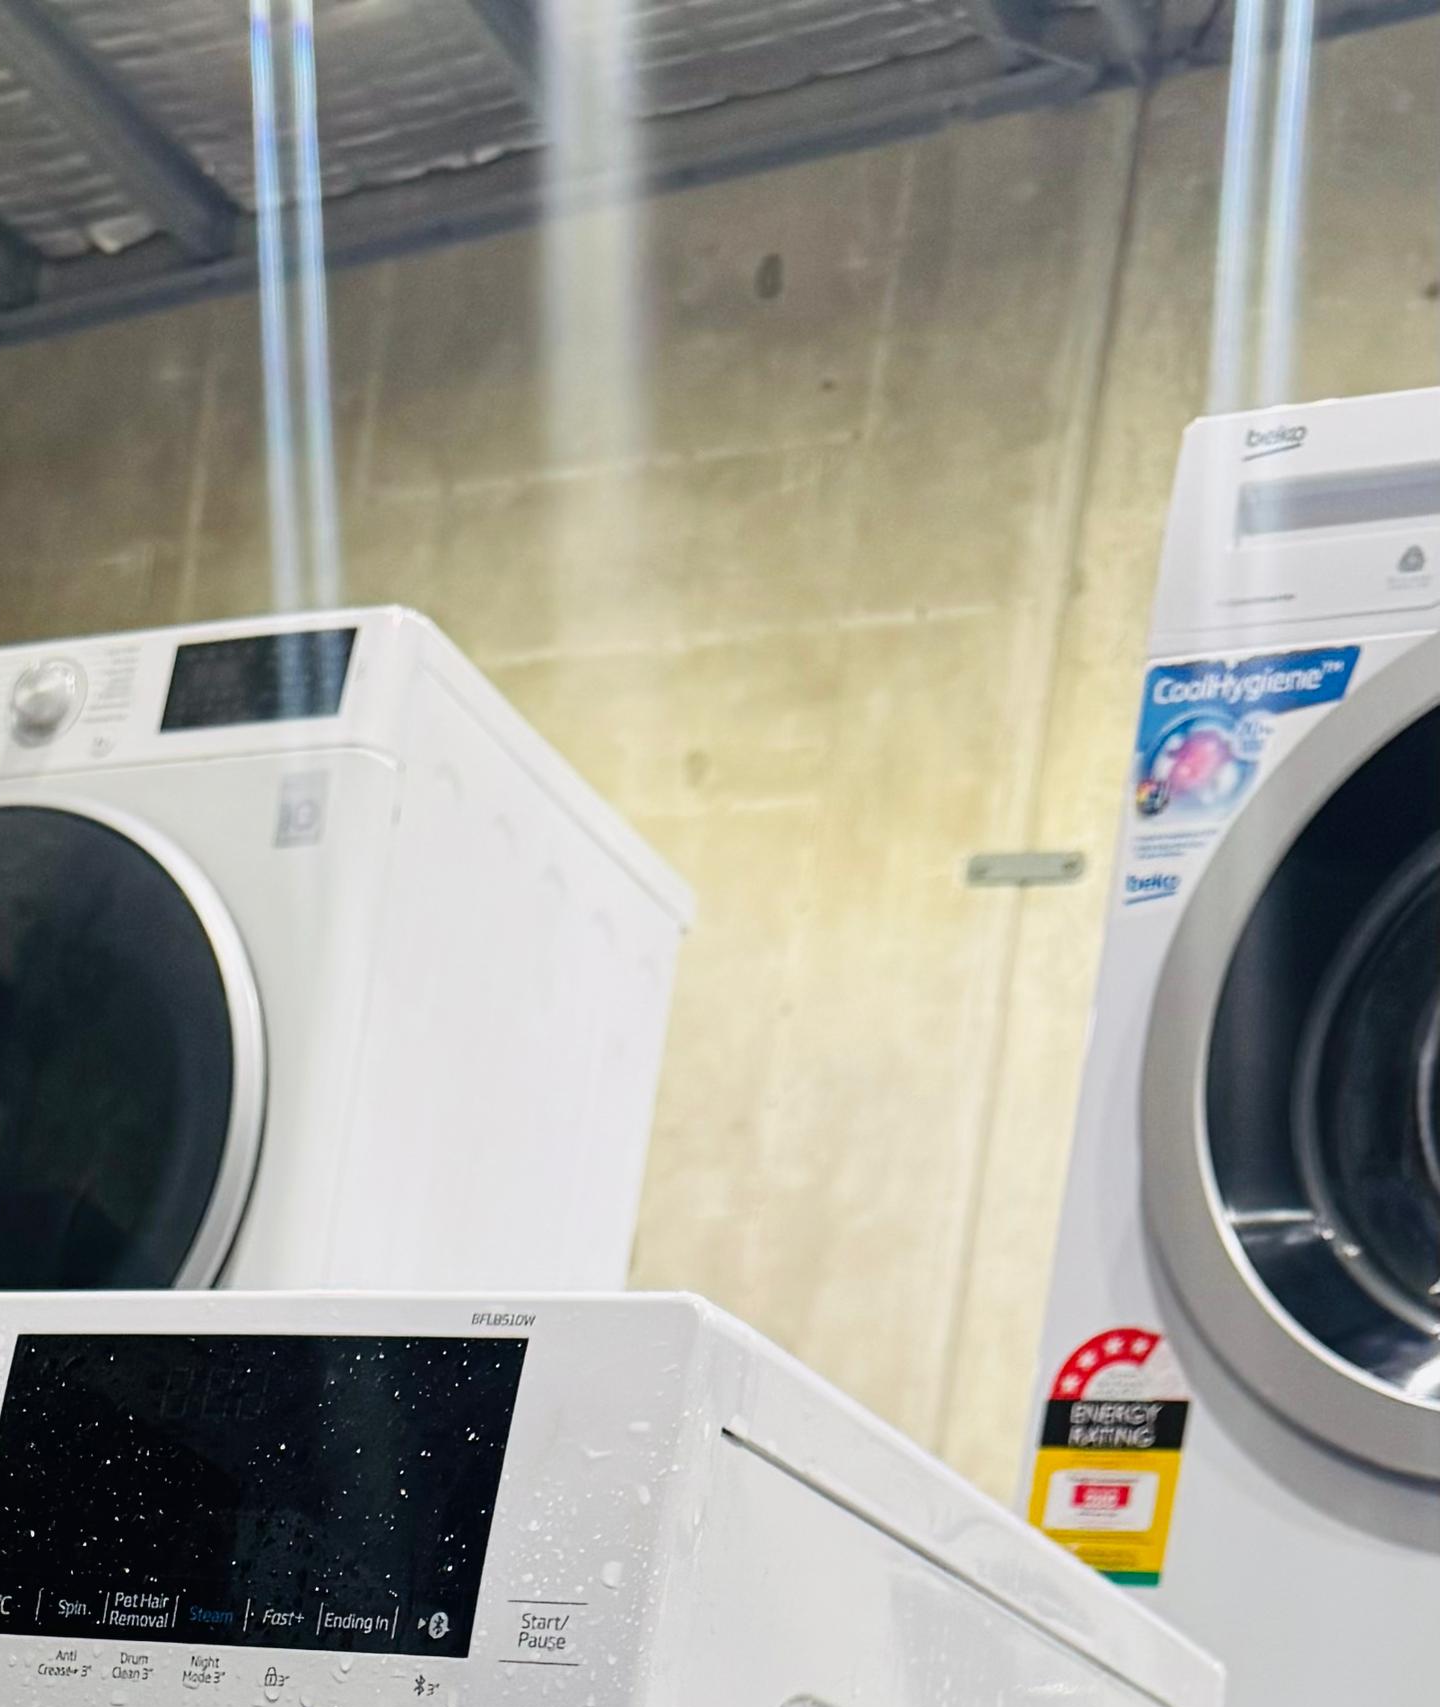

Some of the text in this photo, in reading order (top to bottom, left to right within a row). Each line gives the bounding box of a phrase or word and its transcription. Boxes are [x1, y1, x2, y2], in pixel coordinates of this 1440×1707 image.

[57, 1599, 87, 1619] Spin
[114, 1591, 170, 1609] Pet Hair
[109, 1609, 170, 1629] Removal
[189, 1604, 235, 1625] Steam
[262, 1609, 305, 1627] Fast+
[324, 1612, 391, 1634] Ending In
[521, 1612, 570, 1631] Start/
[518, 1633, 567, 1651] Pause
[55, 1649, 78, 1662] Anti
[120, 1651, 149, 1665] Drum
[190, 1655, 220, 1672] Night
[111, 1666, 141, 1680] Clean
[182, 1670, 212, 1684] Mode
